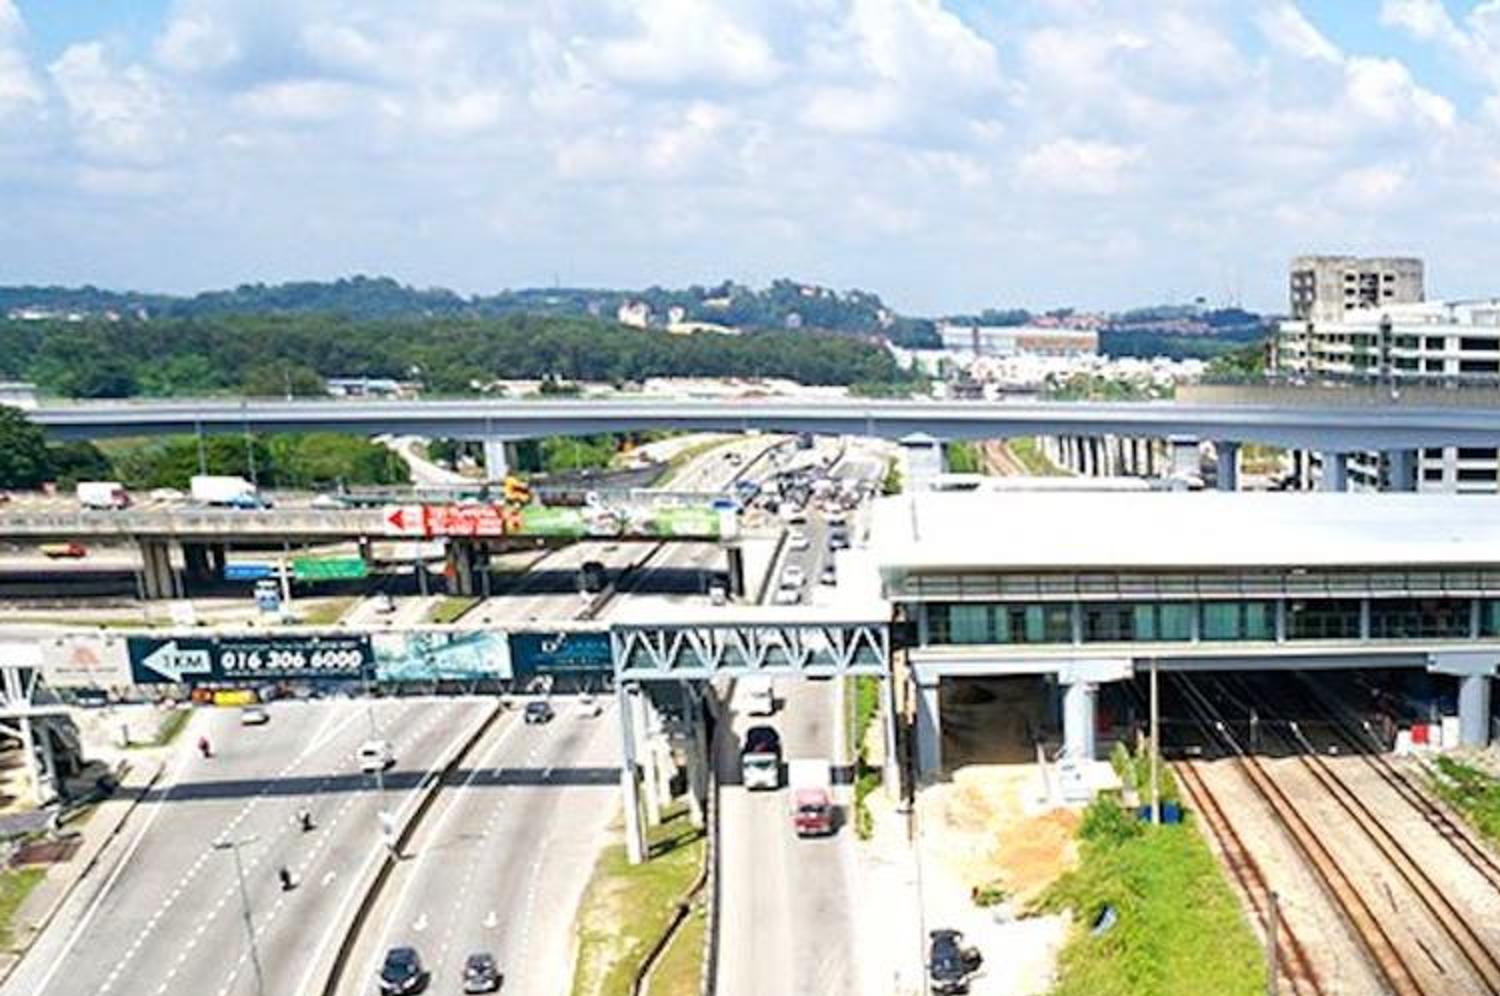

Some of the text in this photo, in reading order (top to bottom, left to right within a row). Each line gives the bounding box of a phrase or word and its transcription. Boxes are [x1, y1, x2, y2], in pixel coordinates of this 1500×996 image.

[221, 649, 362, 671] 016 306 6000
